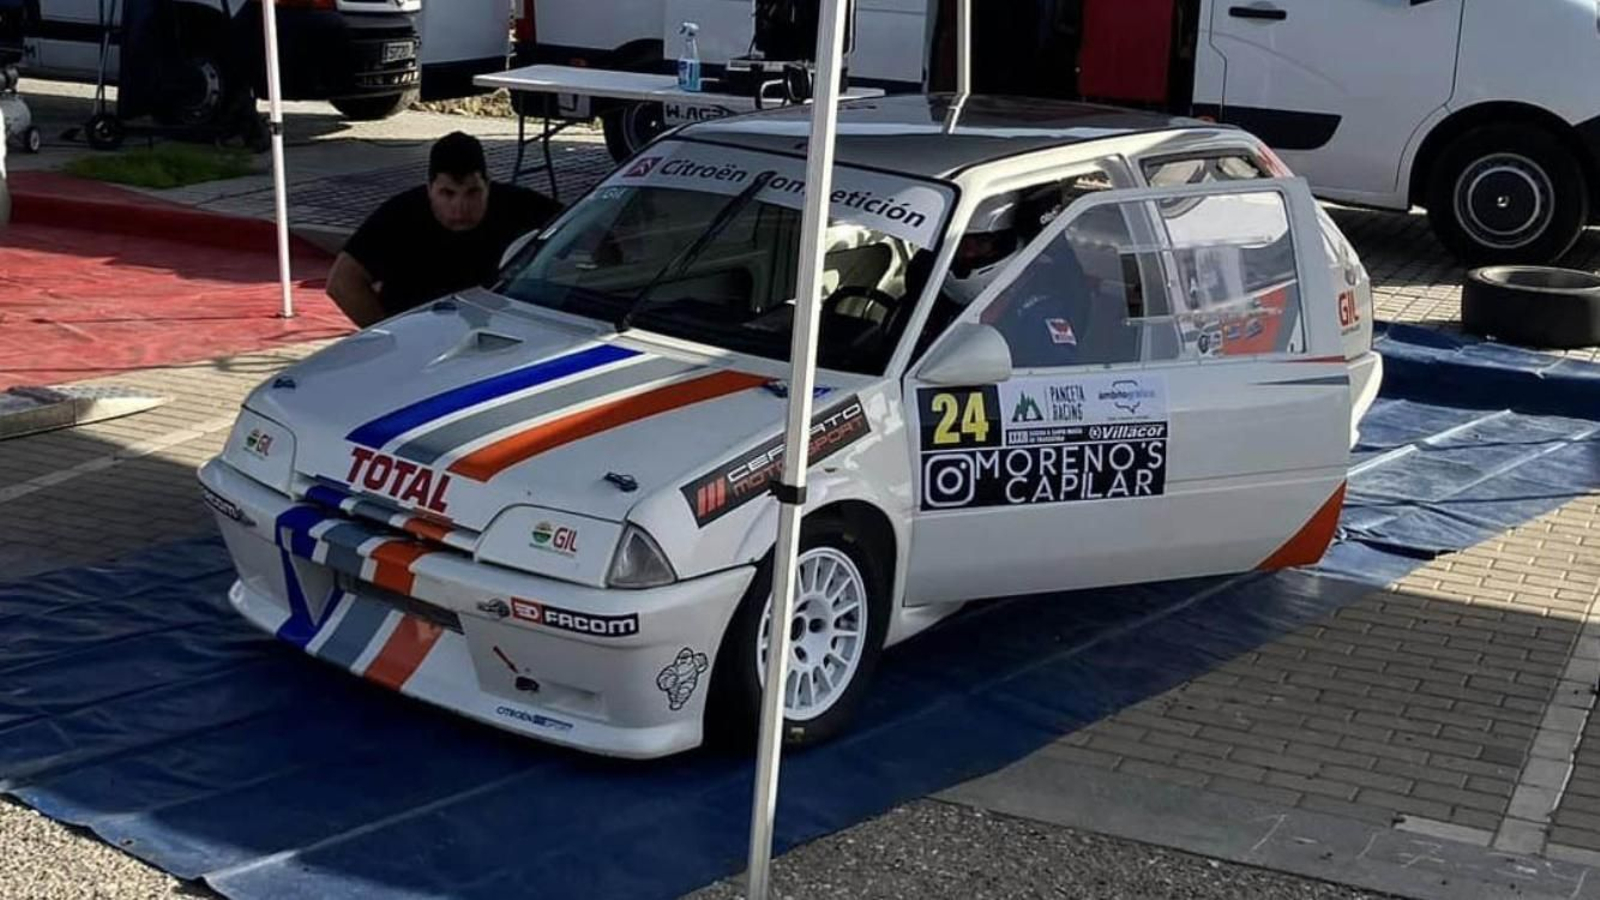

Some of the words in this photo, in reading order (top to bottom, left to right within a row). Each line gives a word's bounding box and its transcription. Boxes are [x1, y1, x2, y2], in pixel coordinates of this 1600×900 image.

[660, 157, 748, 184] Citroën
[754, 170, 927, 229] Cometición
[1050, 385, 1086, 402] PANCETA
[931, 391, 990, 445] 24
[1052, 402, 1084, 421] RACING
[727, 402, 862, 483] CERATO
[1102, 424, 1165, 439] Villacor
[975, 441, 1164, 481] MORENO'S
[346, 446, 452, 514] TOTAL
[1005, 469, 1154, 504] CAPILAR
[553, 526, 578, 553] GIL
[544, 610, 636, 634] FACOM
